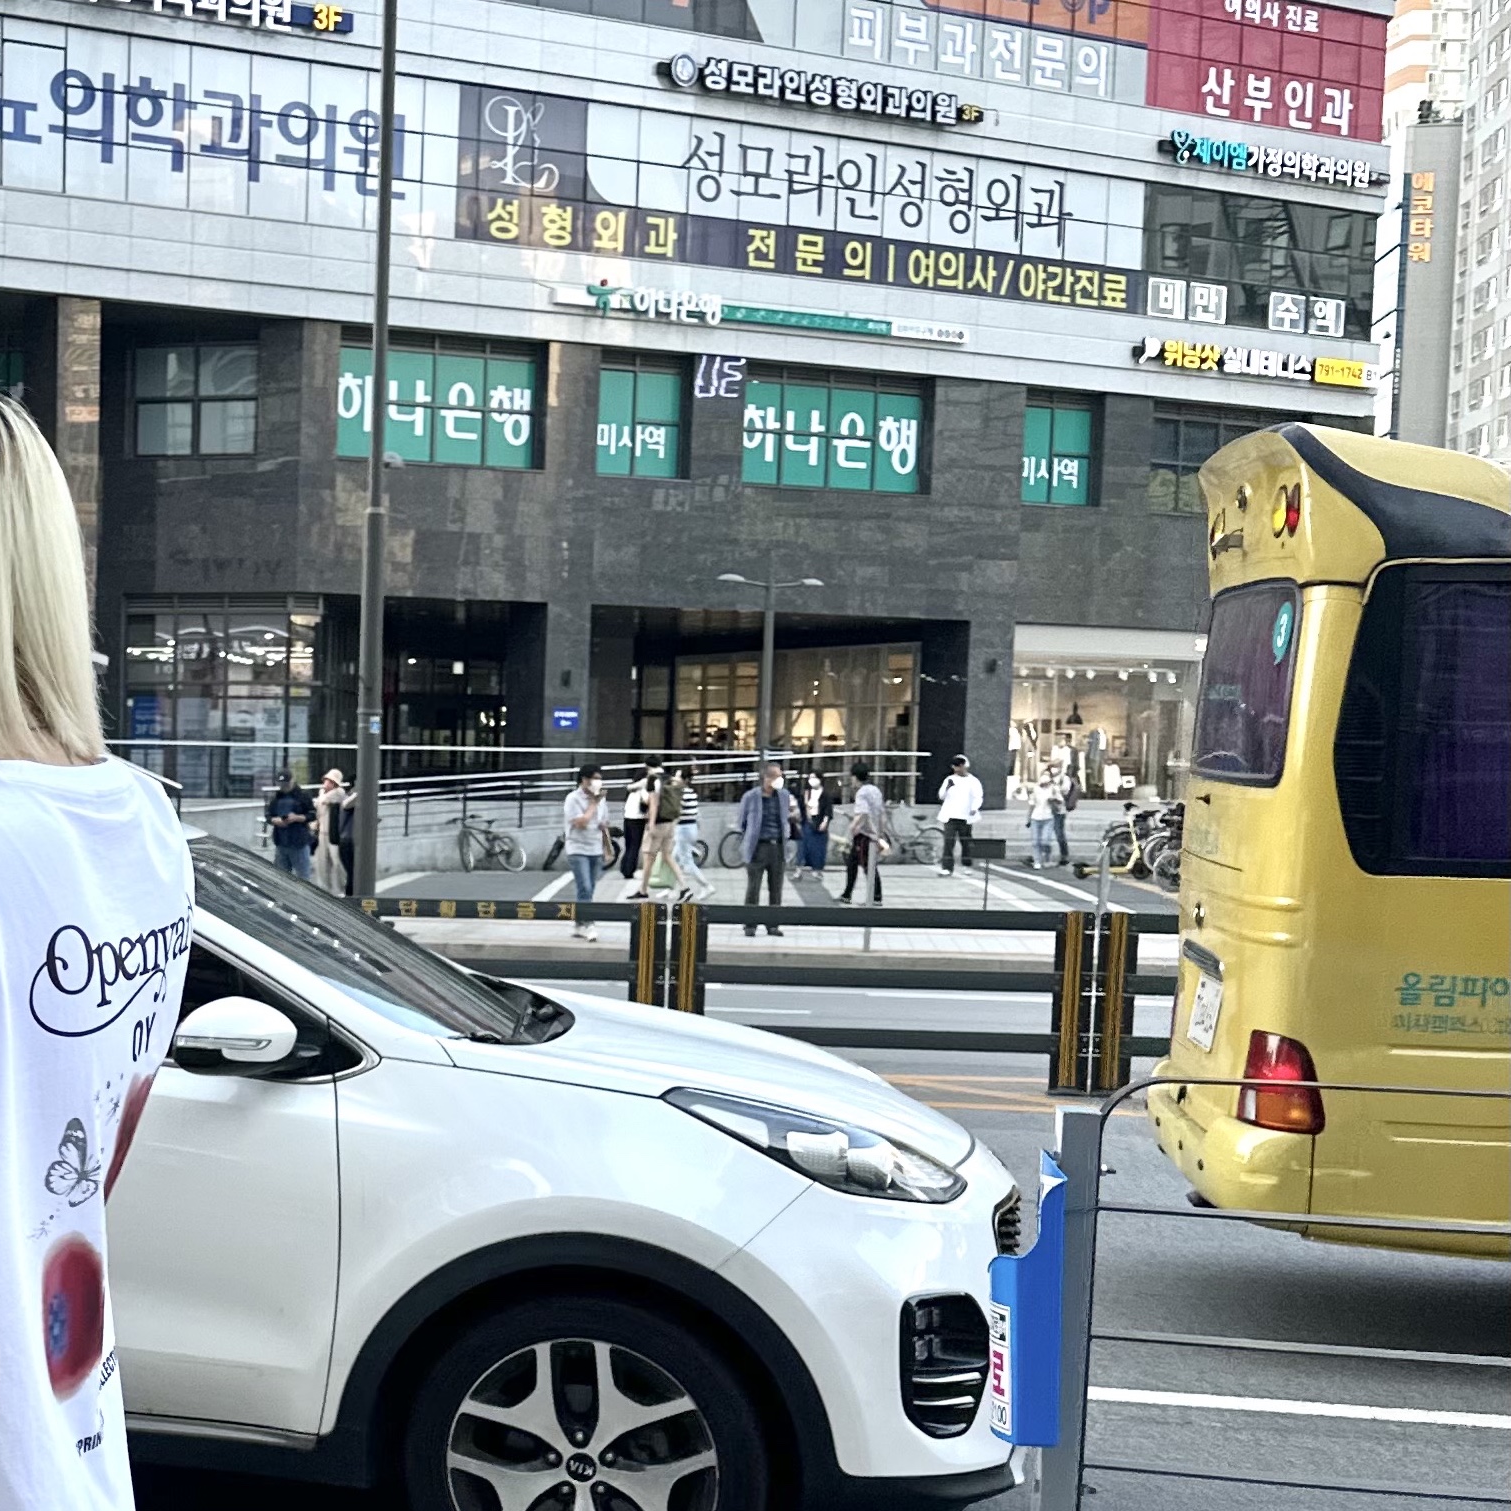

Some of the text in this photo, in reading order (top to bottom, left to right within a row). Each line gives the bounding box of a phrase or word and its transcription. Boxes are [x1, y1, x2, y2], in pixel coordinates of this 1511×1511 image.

[313, 4, 344, 31] 3F
[1286, 9, 1320, 33] 진료
[849, 7, 1108, 97] 피부과전문의
[703, 58, 980, 125] 성모라인성형외과의원 3F
[1201, 66, 1354, 136] 산부인과
[684, 131, 1073, 249] 성모라인성형외과
[1192, 137, 1371, 189] 제이엠가정의학과의원
[487, 198, 679, 259] 성형외과
[746, 229, 873, 281] 전문의
[1408, 172, 1435, 263] 에코타워
[1164, 339, 1221, 371] 위닝샷
[337, 371, 532, 448] 하나은행
[596, 420, 667, 459] 미사역
[743, 403, 919, 476] 하나은행
[1022, 455, 1080, 489] 미사역
[1276, 613, 1288, 648] 3
[568, 1459, 595, 1477] KIA
